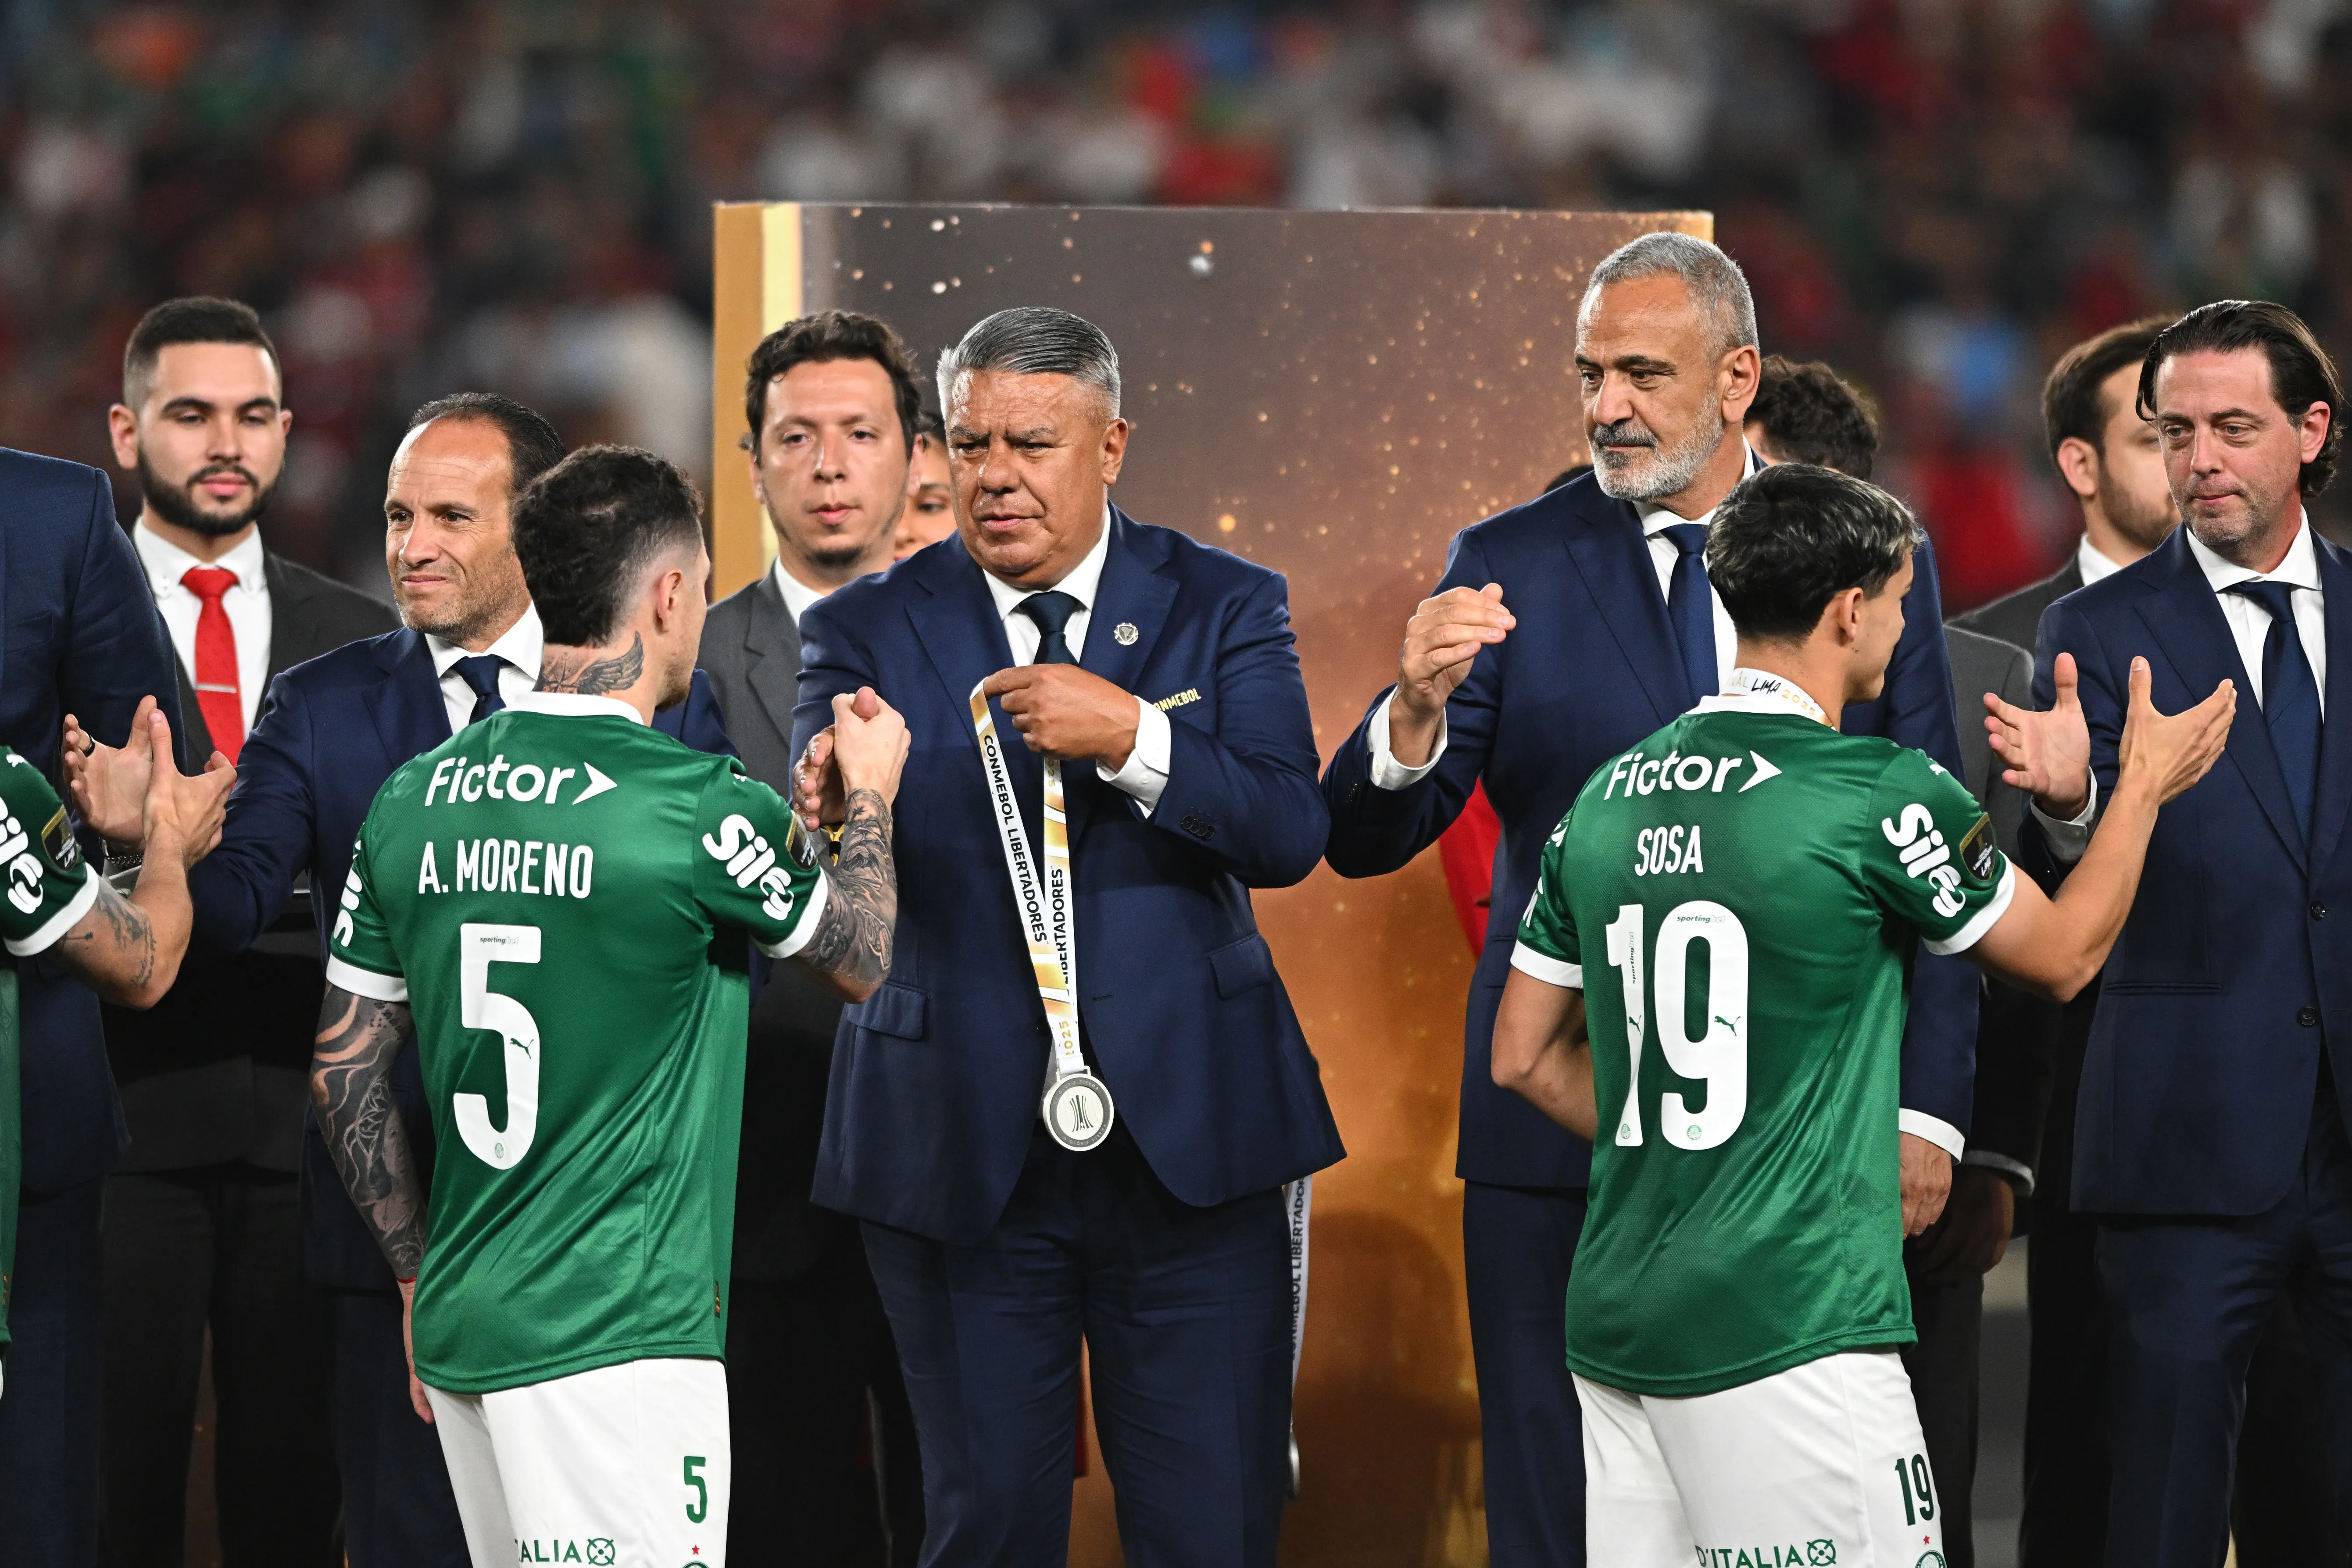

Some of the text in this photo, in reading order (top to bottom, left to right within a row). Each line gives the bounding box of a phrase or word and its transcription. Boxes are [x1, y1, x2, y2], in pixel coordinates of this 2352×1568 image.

[1153, 688, 1202, 711] ONMEBOL
[1751, 678, 1781, 694] LIMA
[1781, 689, 1816, 716] 2025
[425, 754, 576, 807] Fictor
[1604, 750, 1743, 800] Fictor
[984, 735, 1047, 942] CONMEBOL LIBERTADORES
[1635, 825, 1704, 876] SOSA
[418, 841, 449, 894] A.
[457, 838, 594, 899] MORENO
[480, 936, 519, 945] sportingbet
[453, 923, 541, 1170] 5
[1605, 900, 1749, 1150] 19
[1292, 1178, 1305, 1269] LIBERTADOR
[684, 1456, 708, 1523] 5
[1895, 1454, 1934, 1526] 19
[515, 1539, 583, 1562] ALIA
